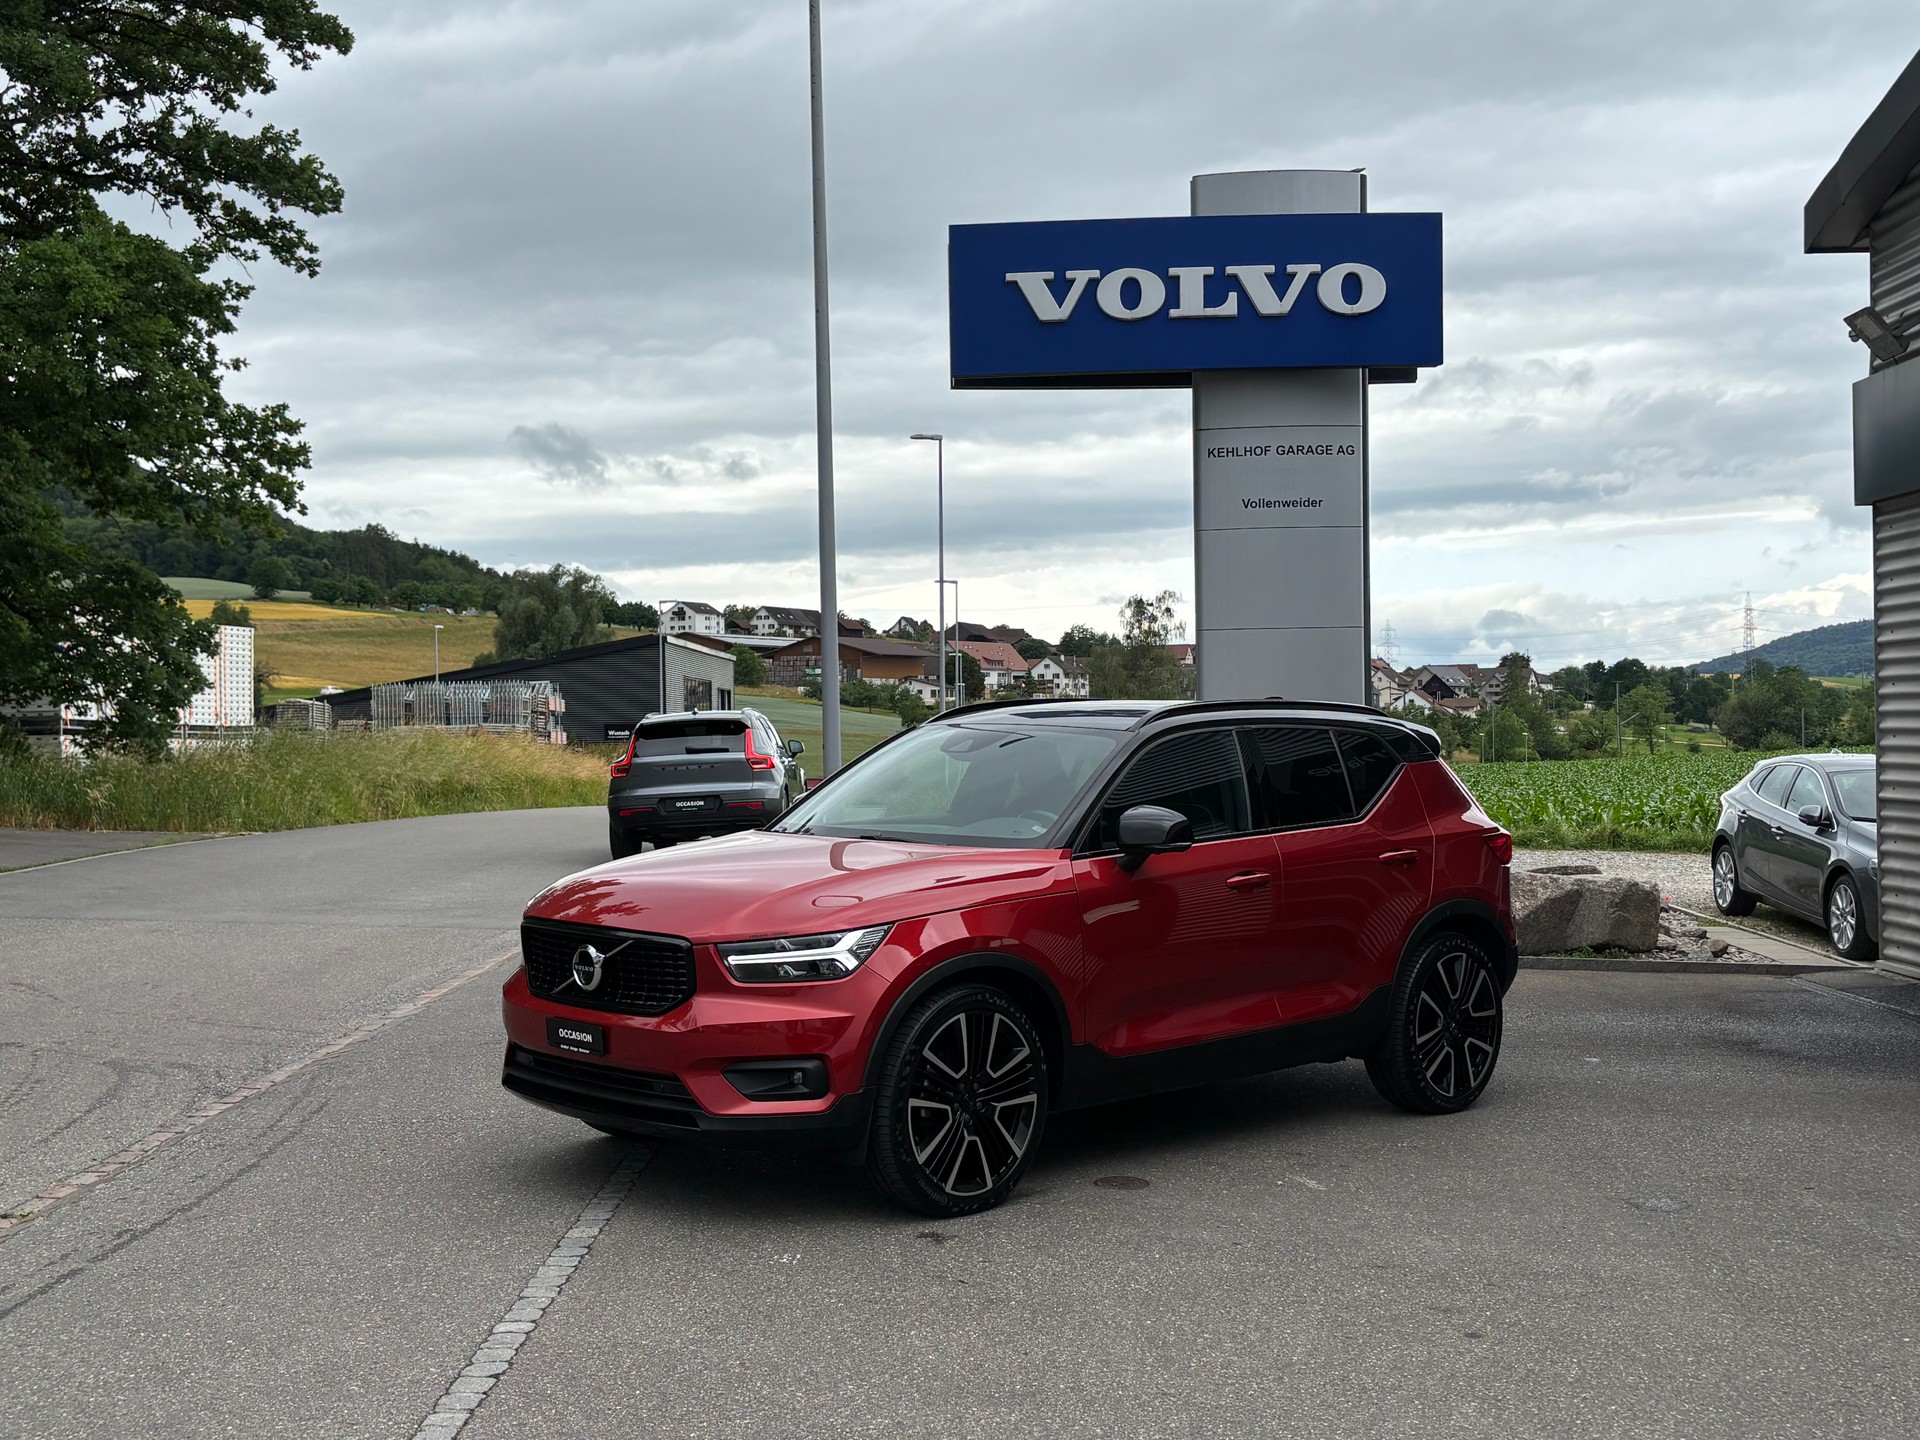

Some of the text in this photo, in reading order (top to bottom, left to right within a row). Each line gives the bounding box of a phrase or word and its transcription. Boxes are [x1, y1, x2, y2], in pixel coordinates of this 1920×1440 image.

[1005, 262, 1387, 322] VOLVO
[1207, 444, 1355, 459] KEHLHOF GARAGE AG
[1241, 497, 1324, 509] Vollenweider
[574, 964, 594, 972] VOLVO
[558, 1028, 593, 1043] OCCASION
